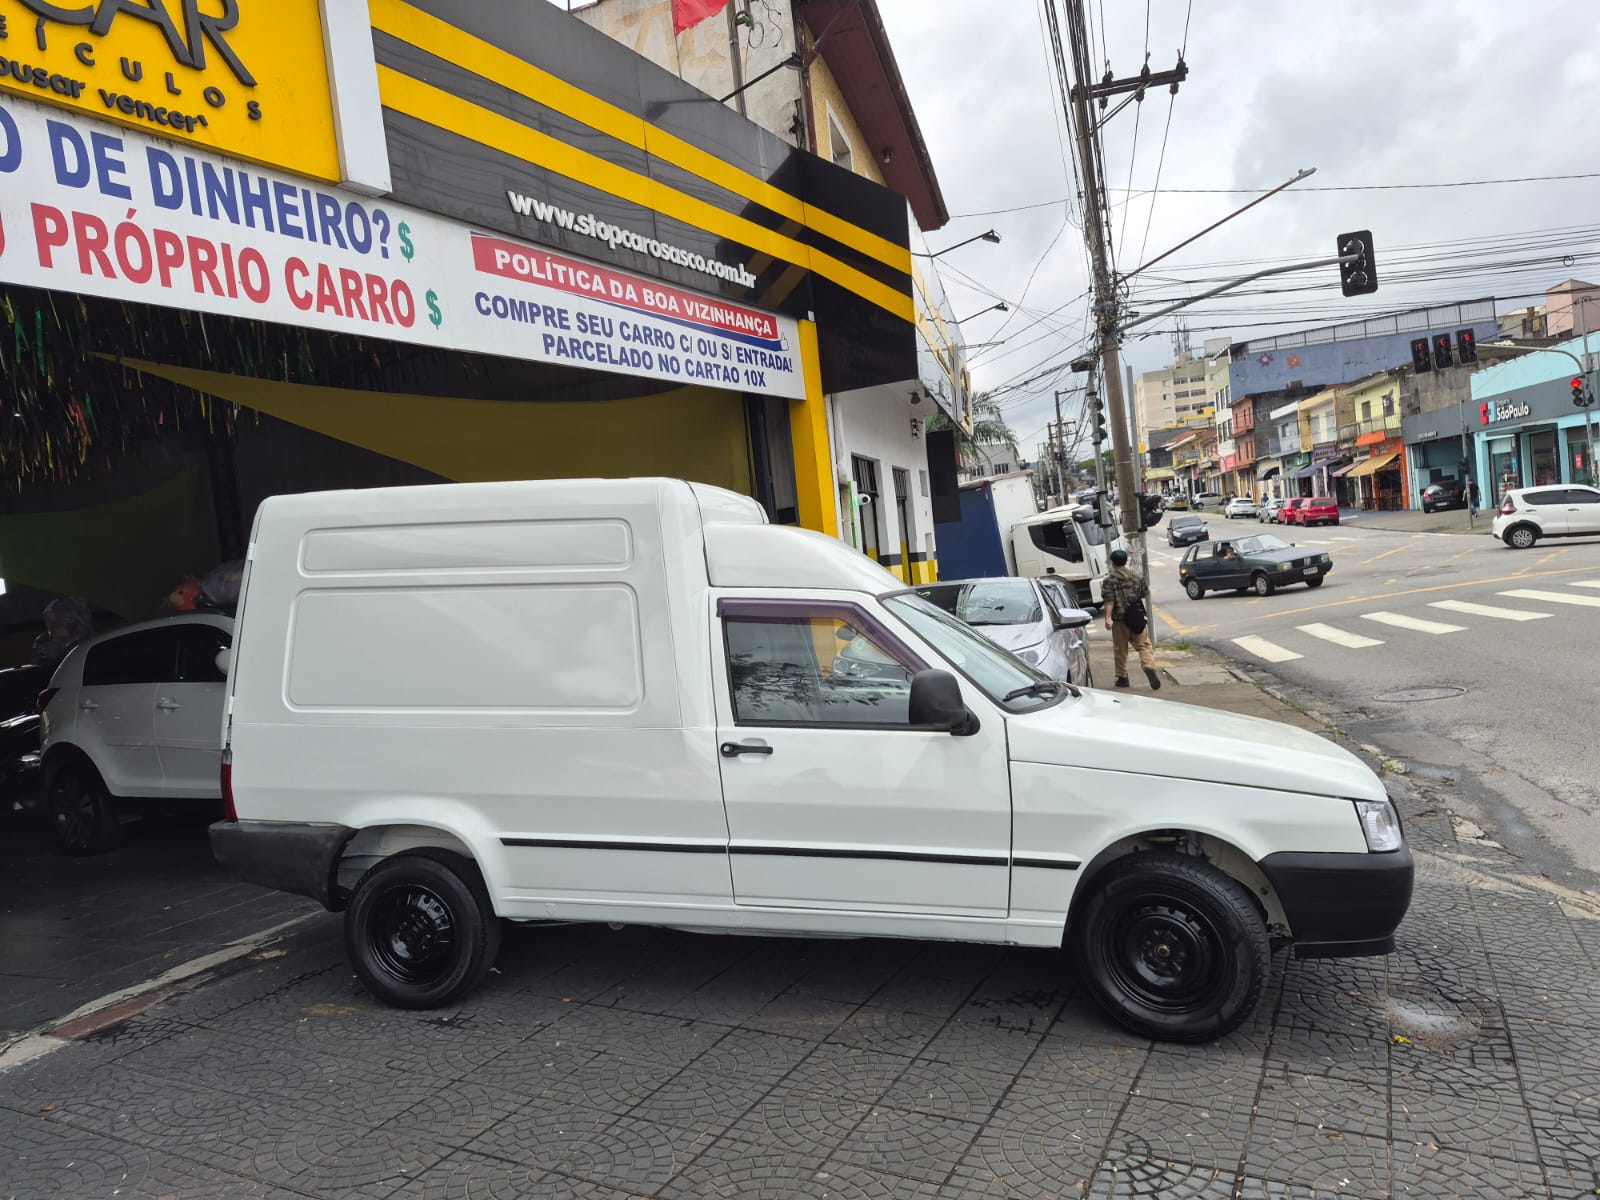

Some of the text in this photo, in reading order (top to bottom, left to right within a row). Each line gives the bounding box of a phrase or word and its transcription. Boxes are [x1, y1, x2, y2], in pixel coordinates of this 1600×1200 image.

[18, 0, 258, 88] AR
[46, 118, 132, 201] DE
[146, 146, 391, 260] DINHEIRO?
[31, 202, 271, 305] PRÓPRIO
[284, 256, 416, 329] CARRO
[507, 190, 757, 289] www.stopcarosasco.com.br
[474, 291, 571, 330] COMPRE
[576, 311, 614, 339] SEU
[619, 322, 675, 352] CARRO
[680, 334, 693, 354] C/
[697, 336, 718, 359] OU
[736, 348, 794, 374] ENTRADA!
[494, 247, 773, 337] POLÍTICA DA BOA VIZINHANÇA
[542, 333, 767, 388] PARCELADO NO CARTAO 10X
